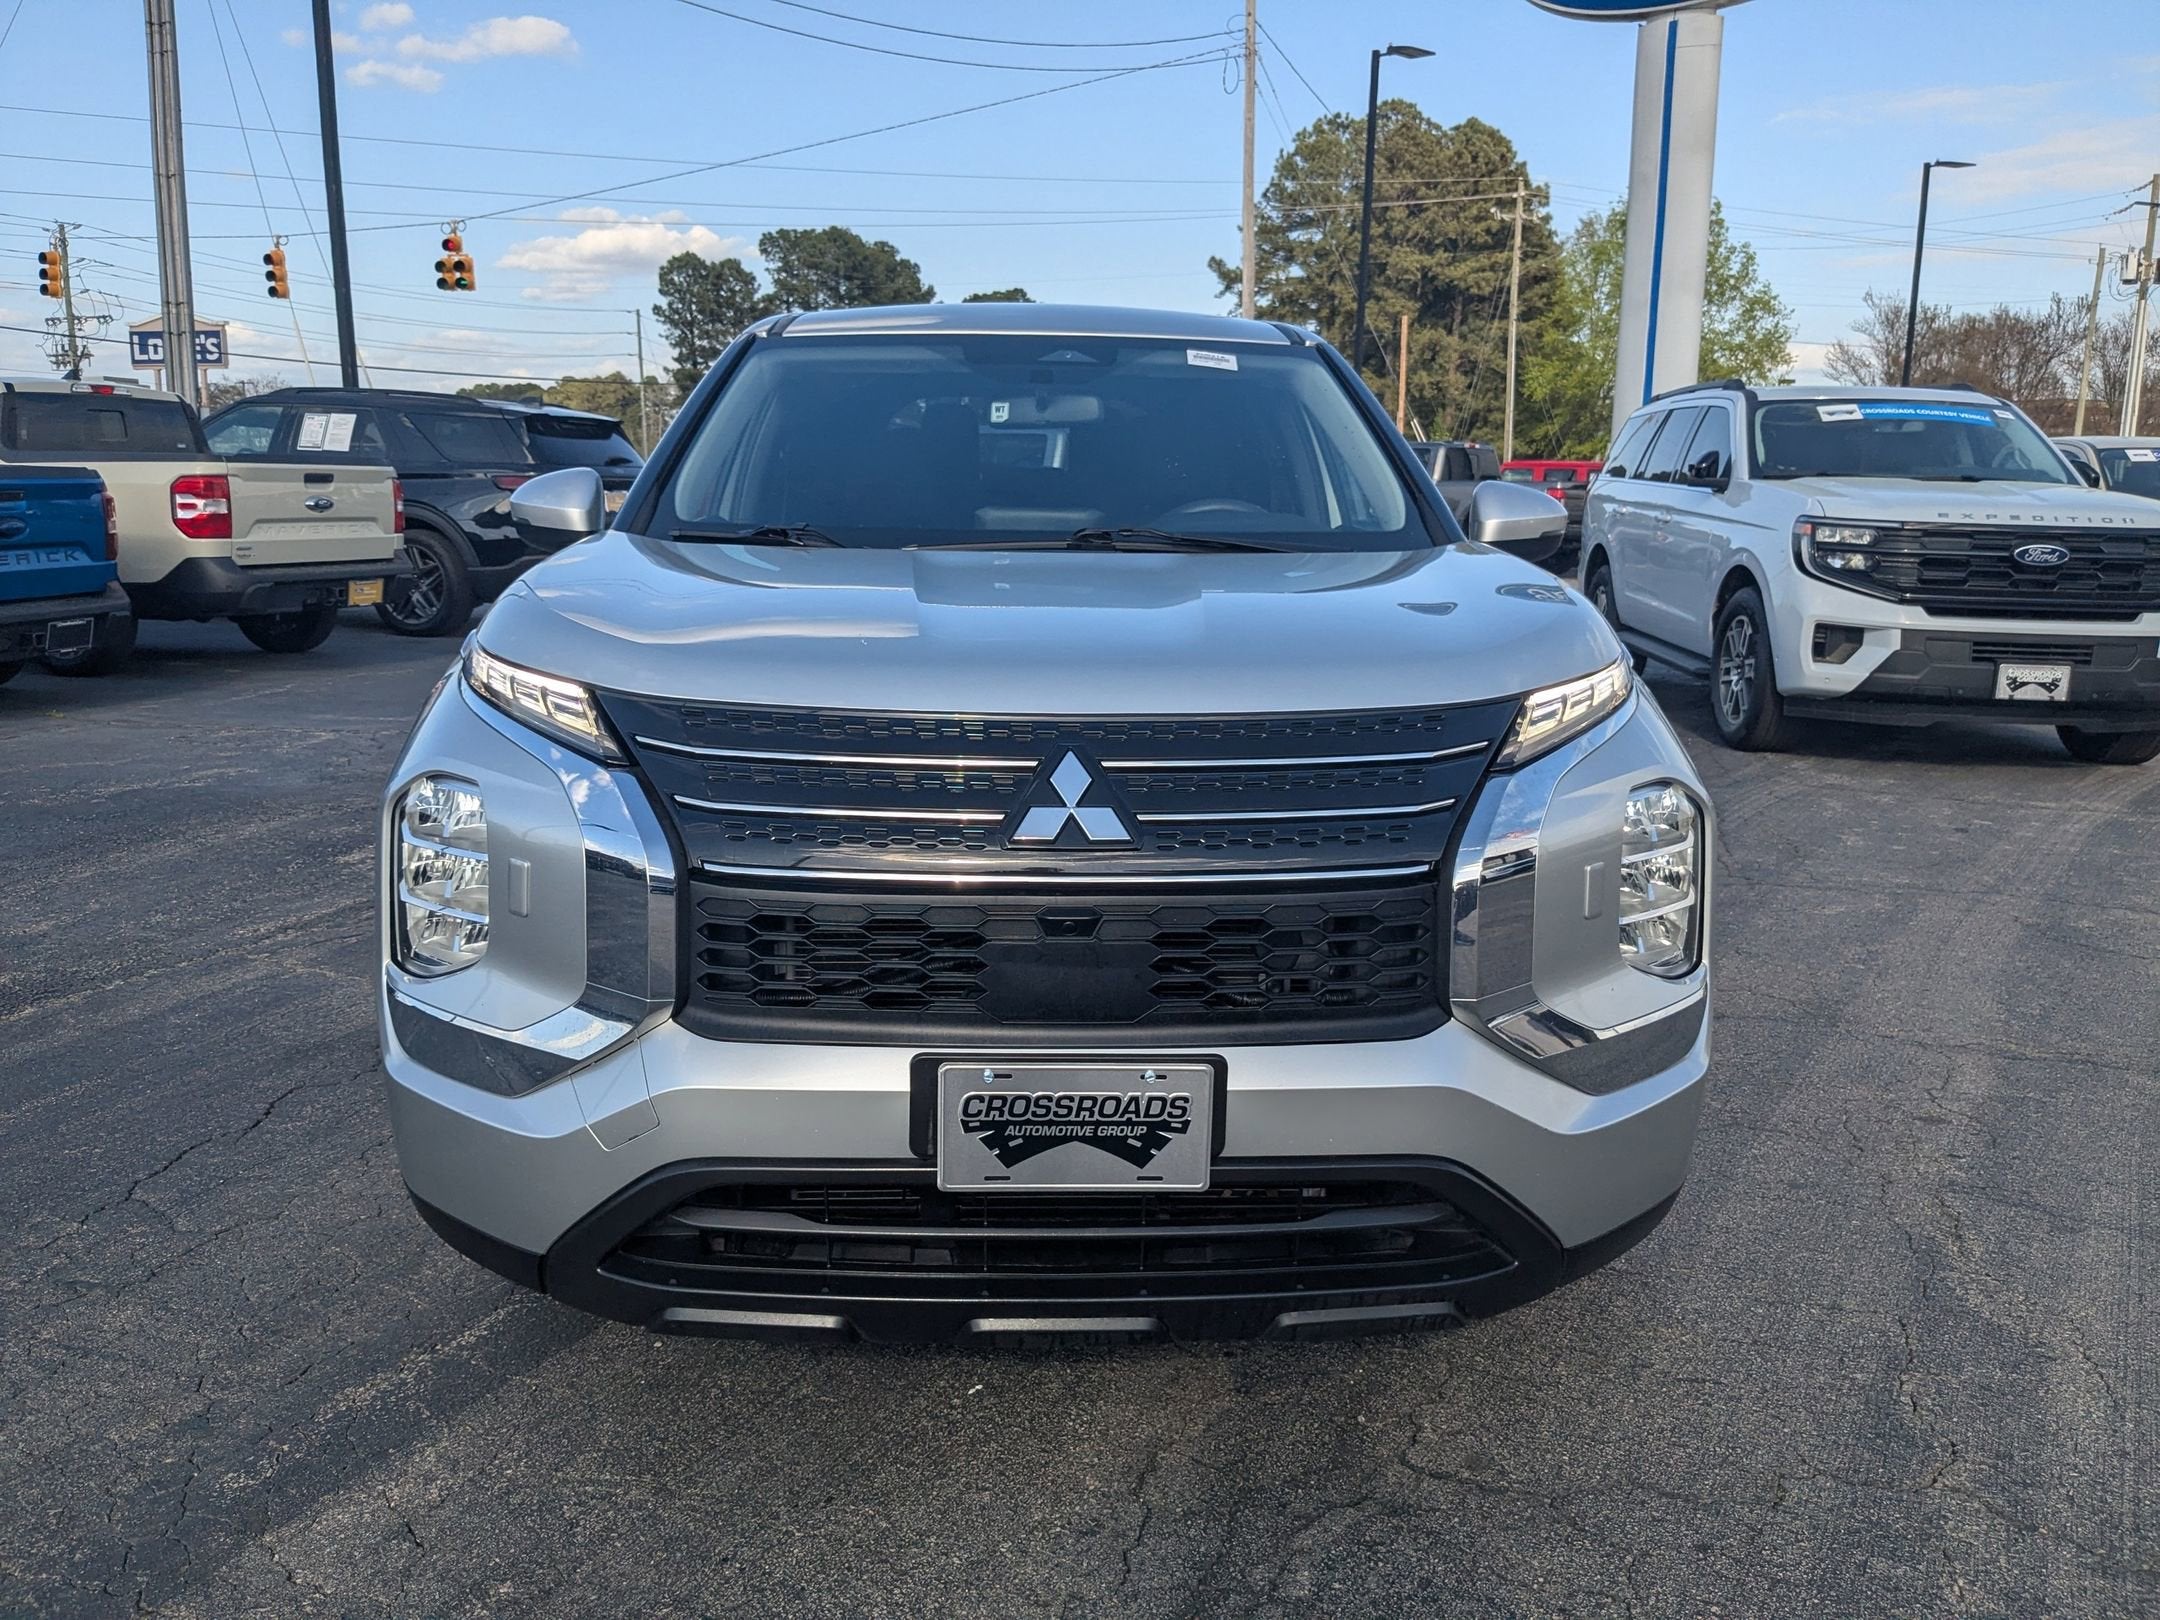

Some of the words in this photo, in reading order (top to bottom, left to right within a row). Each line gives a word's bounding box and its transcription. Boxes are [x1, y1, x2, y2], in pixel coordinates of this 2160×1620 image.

[133, 334, 220, 360] LOE'S
[1860, 407, 1915, 415] CROSSROADS
[1916, 408, 1957, 417] COURTESY
[1958, 413, 1992, 422] VEHICLE
[1937, 512, 2135, 524] EXPEDITION
[2024, 547, 2059, 563] Ford
[961, 1094, 1191, 1120] CROSSROADS
[1004, 1125, 1094, 1137] AUTOMOTIVE
[1097, 1125, 1148, 1137] GROUP
